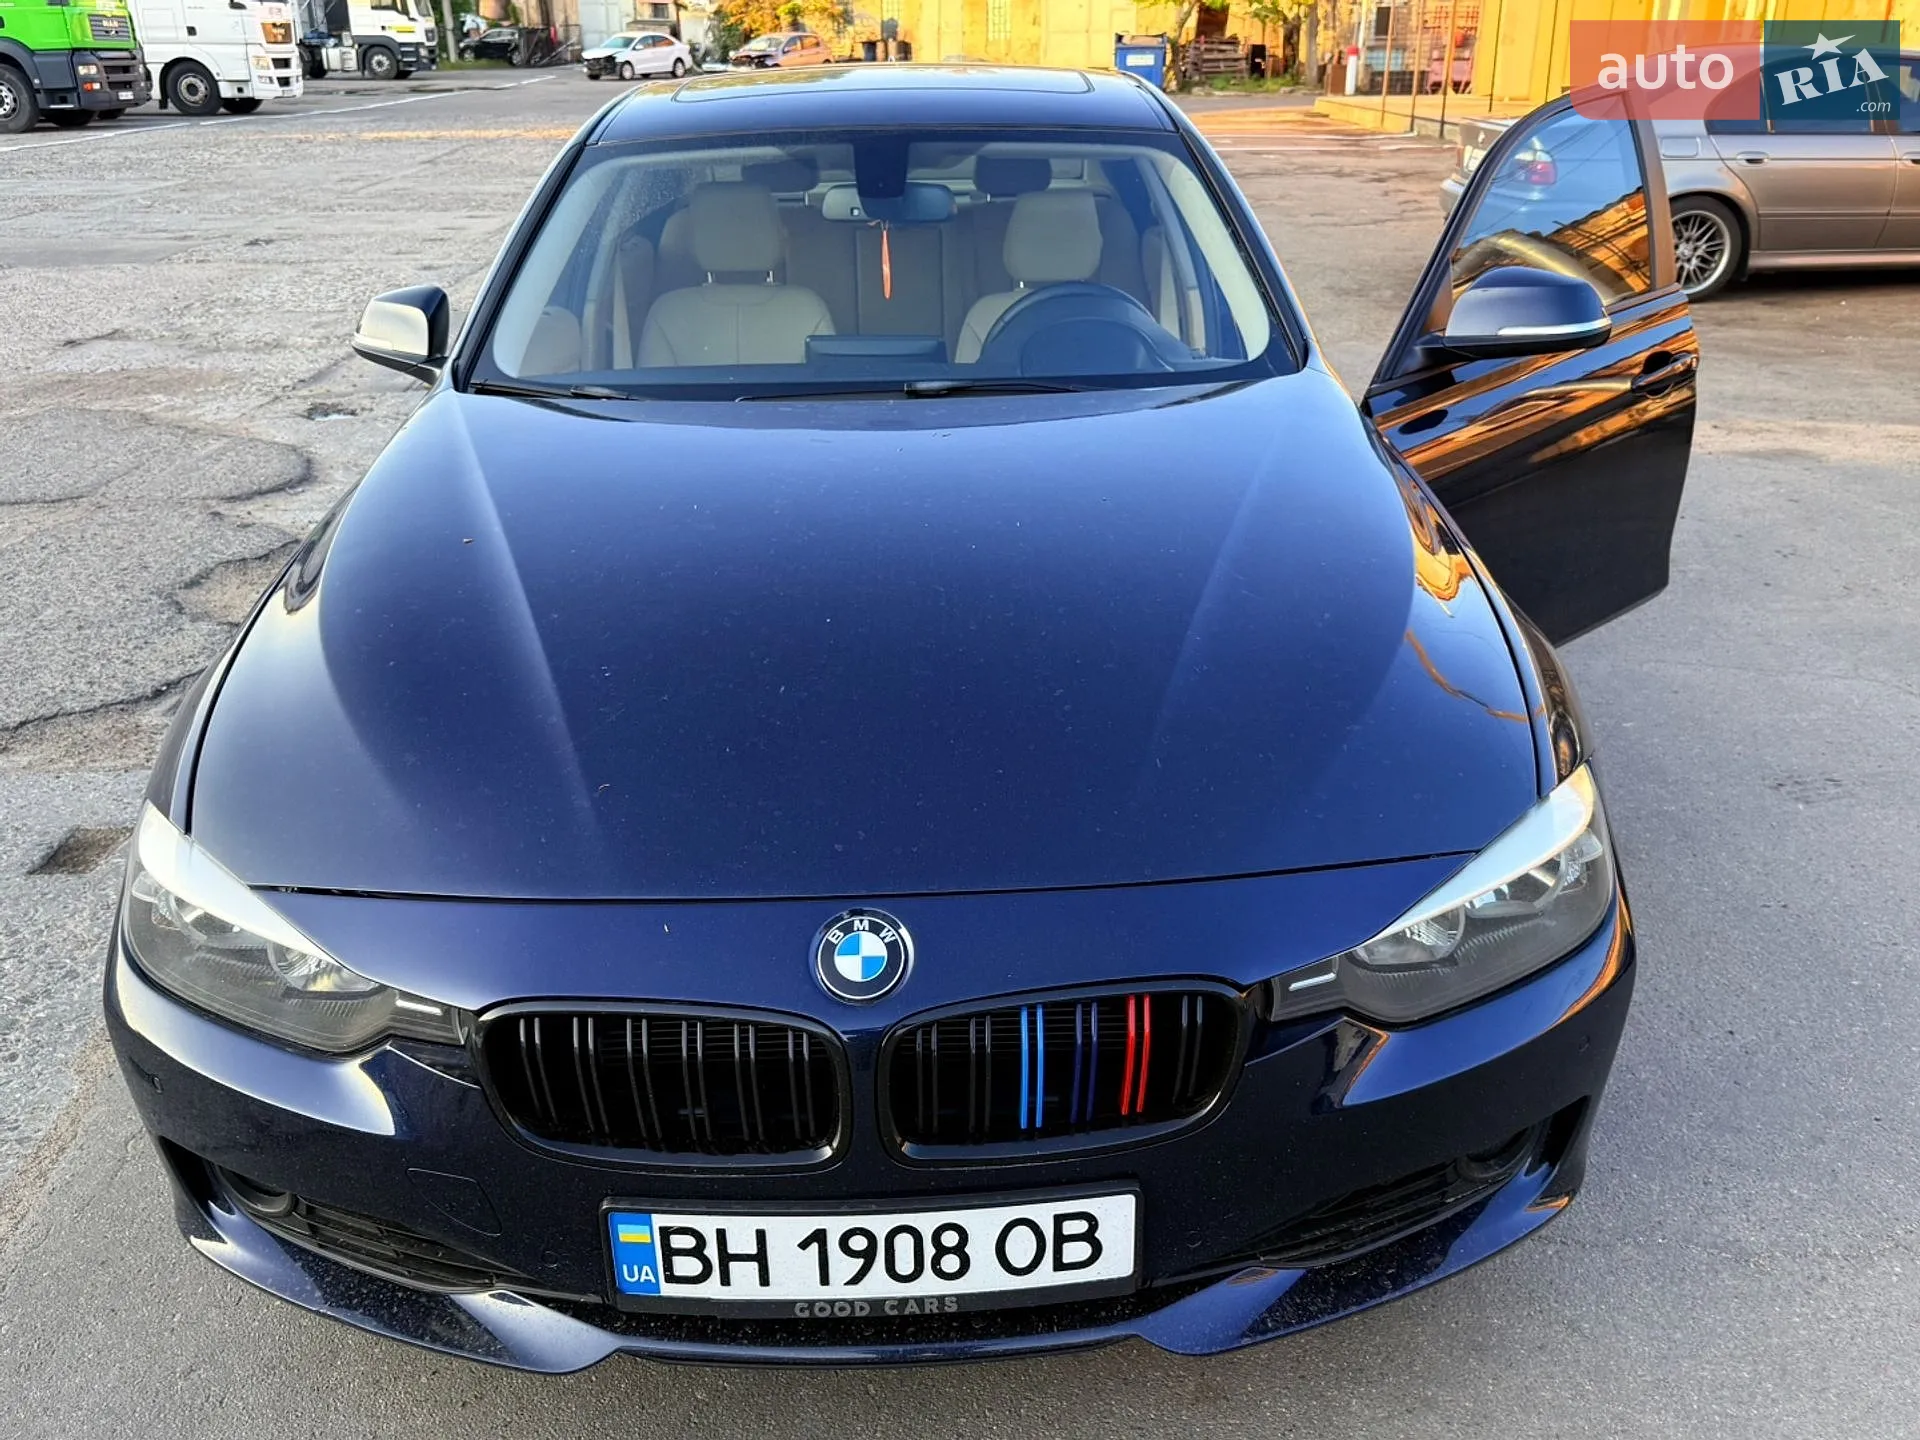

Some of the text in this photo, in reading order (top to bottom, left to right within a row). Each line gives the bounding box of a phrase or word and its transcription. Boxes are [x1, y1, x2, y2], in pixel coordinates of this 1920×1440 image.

[827, 919, 897, 945] BMW
[659, 1210, 1104, 1287] BH 1908 OB
[622, 1264, 656, 1283] UA
[794, 1296, 958, 1318] GOOD CARS
